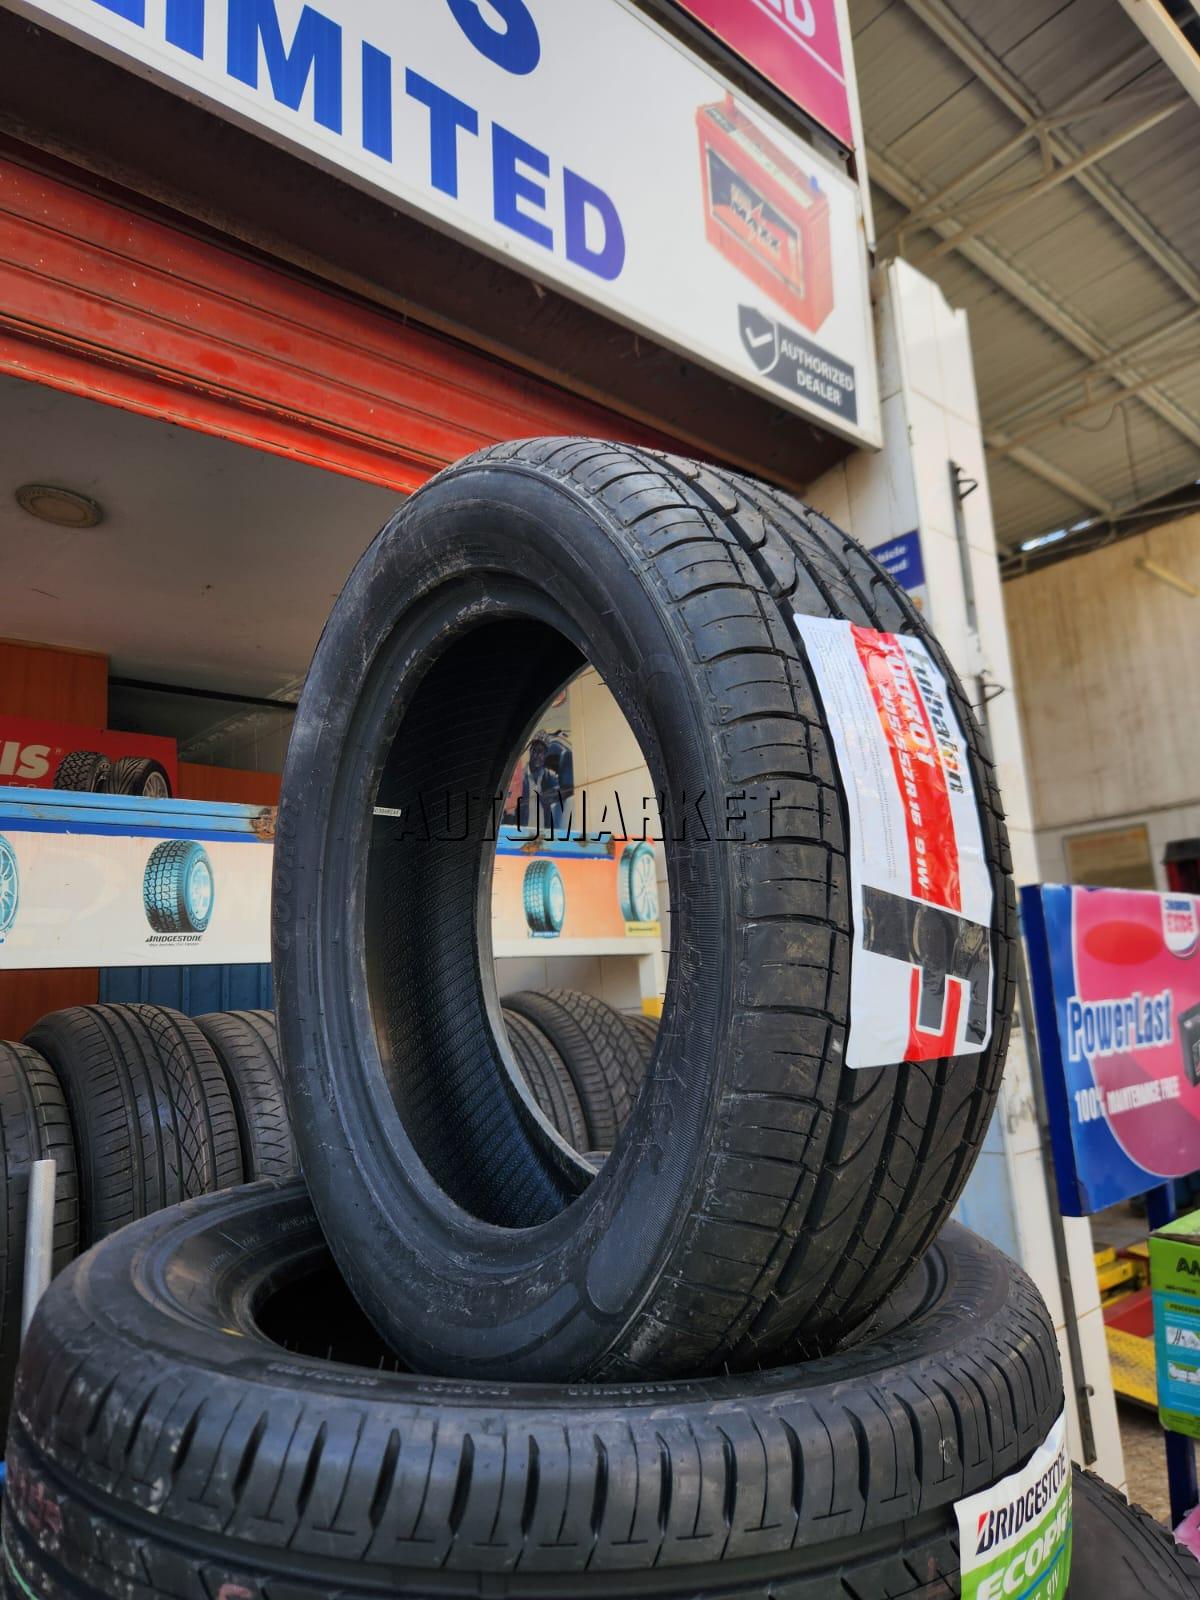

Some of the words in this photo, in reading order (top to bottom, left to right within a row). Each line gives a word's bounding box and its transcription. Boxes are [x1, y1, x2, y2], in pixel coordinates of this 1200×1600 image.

[781, 339, 855, 392] AUTHORIZED
[796, 369, 843, 406] DEALER
[914, 835, 931, 890] 91W
[145, 935, 204, 943] BRIDGESTONE
[1068, 989, 1172, 1061] PowerLast
[1075, 1085, 1105, 1122] 100%
